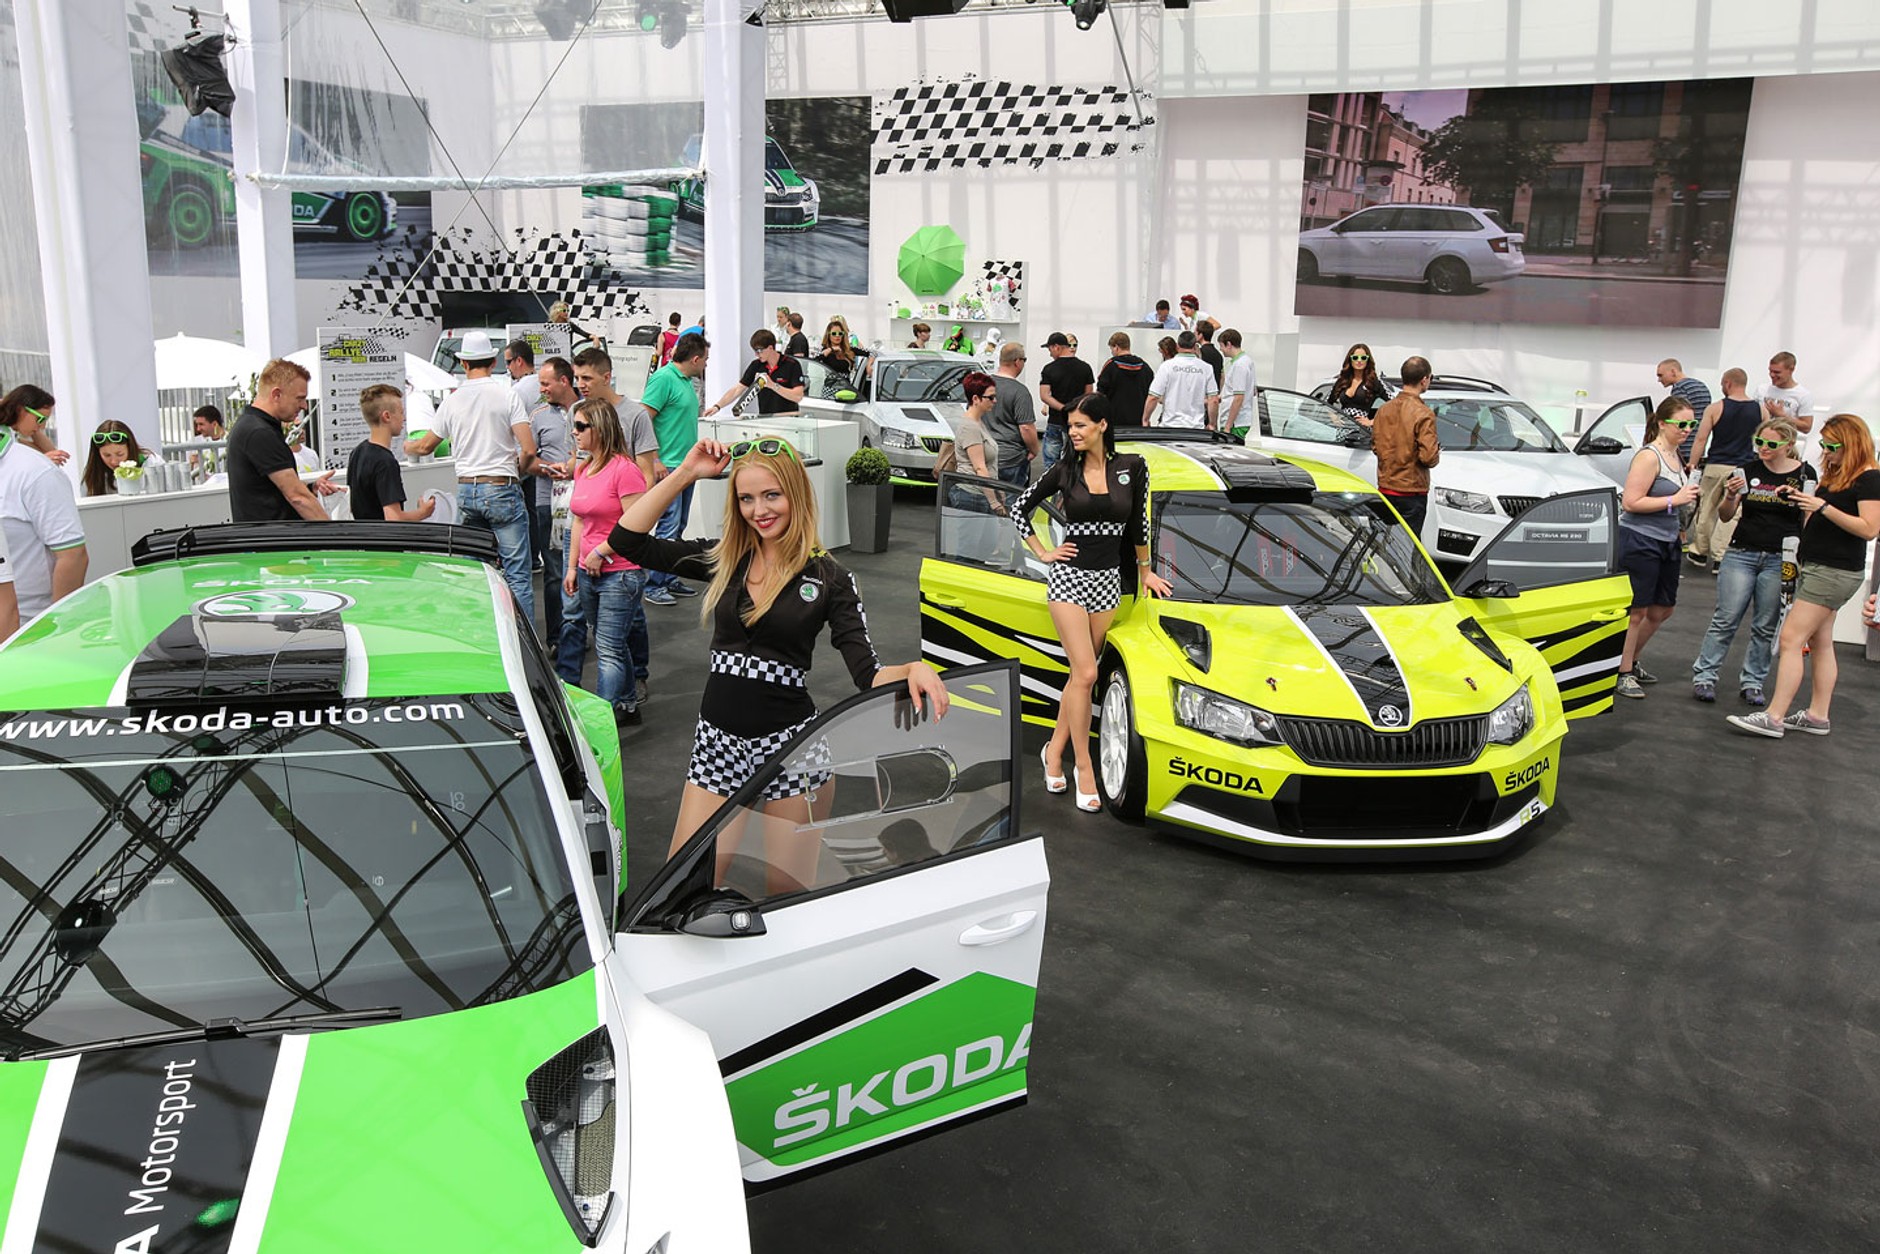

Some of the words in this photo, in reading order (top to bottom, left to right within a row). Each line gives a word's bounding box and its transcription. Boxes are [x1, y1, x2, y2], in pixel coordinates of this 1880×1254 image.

[332, 374, 337, 382] 1
[331, 389, 337, 397] 2
[331, 403, 337, 412] 3
[331, 418, 338, 426] 4
[332, 433, 339, 442] 5
[333, 448, 340, 456] 6
[1168, 756, 1264, 795] ŠKODA
[1504, 756, 1550, 792] ŠKODA
[1520, 801, 1541, 826] R5
[123, 1059, 197, 1215] Motorsport
